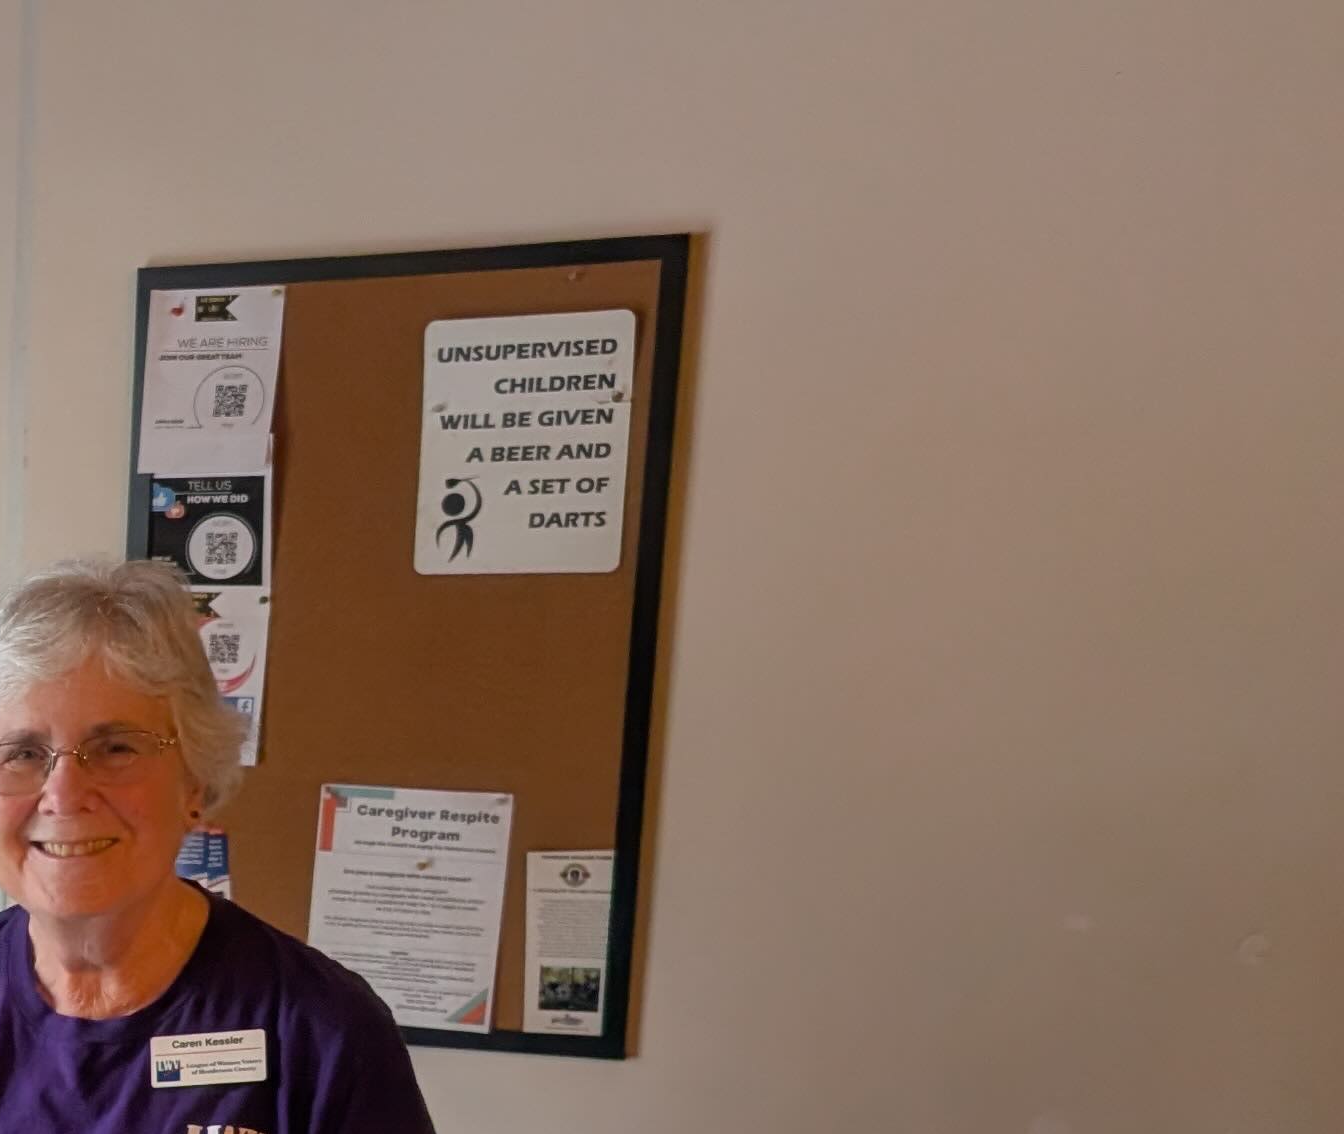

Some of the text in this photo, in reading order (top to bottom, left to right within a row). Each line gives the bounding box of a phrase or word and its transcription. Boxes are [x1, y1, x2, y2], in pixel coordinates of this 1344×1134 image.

[177, 336, 268, 348] WE ARE HIRING
[437, 339, 618, 363] UNSUPERVISED
[494, 374, 616, 394] CHILDREN
[440, 409, 613, 430] WILL BE GIVEN
[466, 443, 611, 463] A BEER AND
[187, 480, 232, 491] TELL US
[504, 477, 609, 495] A SET OF
[187, 494, 248, 504] HOW WE DID
[529, 512, 606, 528] DARTS
[357, 805, 500, 825] Caregiver Respite
[392, 827, 460, 842] Program
[172, 1036, 244, 1049] Caren Kessler
